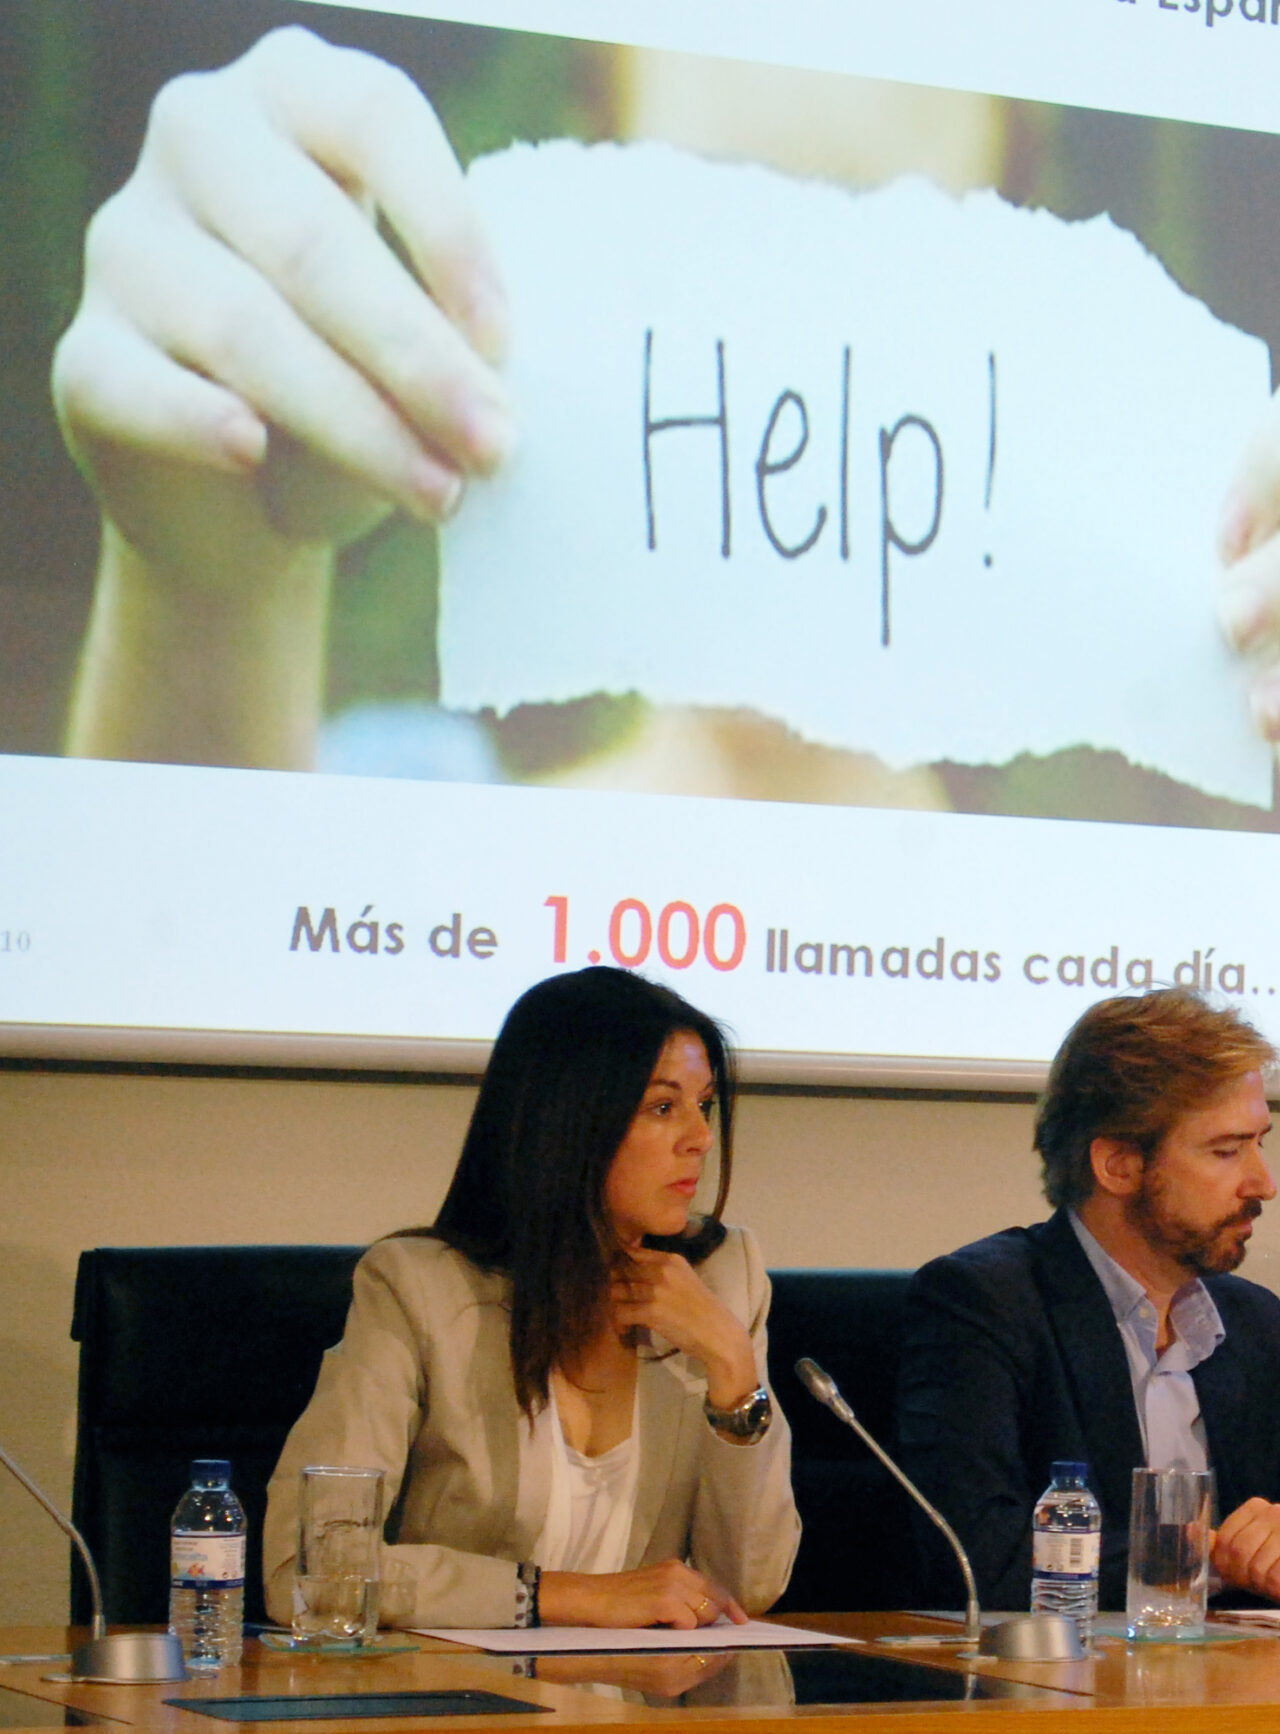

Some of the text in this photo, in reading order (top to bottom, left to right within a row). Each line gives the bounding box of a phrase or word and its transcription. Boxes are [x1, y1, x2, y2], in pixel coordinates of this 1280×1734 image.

[643, 327, 997, 648] Help!
[289, 905, 405, 955] Más
[428, 913, 499, 959] de
[542, 895, 747, 972] 1.000
[765, 928, 1001, 982] llamadas
[1022, 946, 1153, 989] cada
